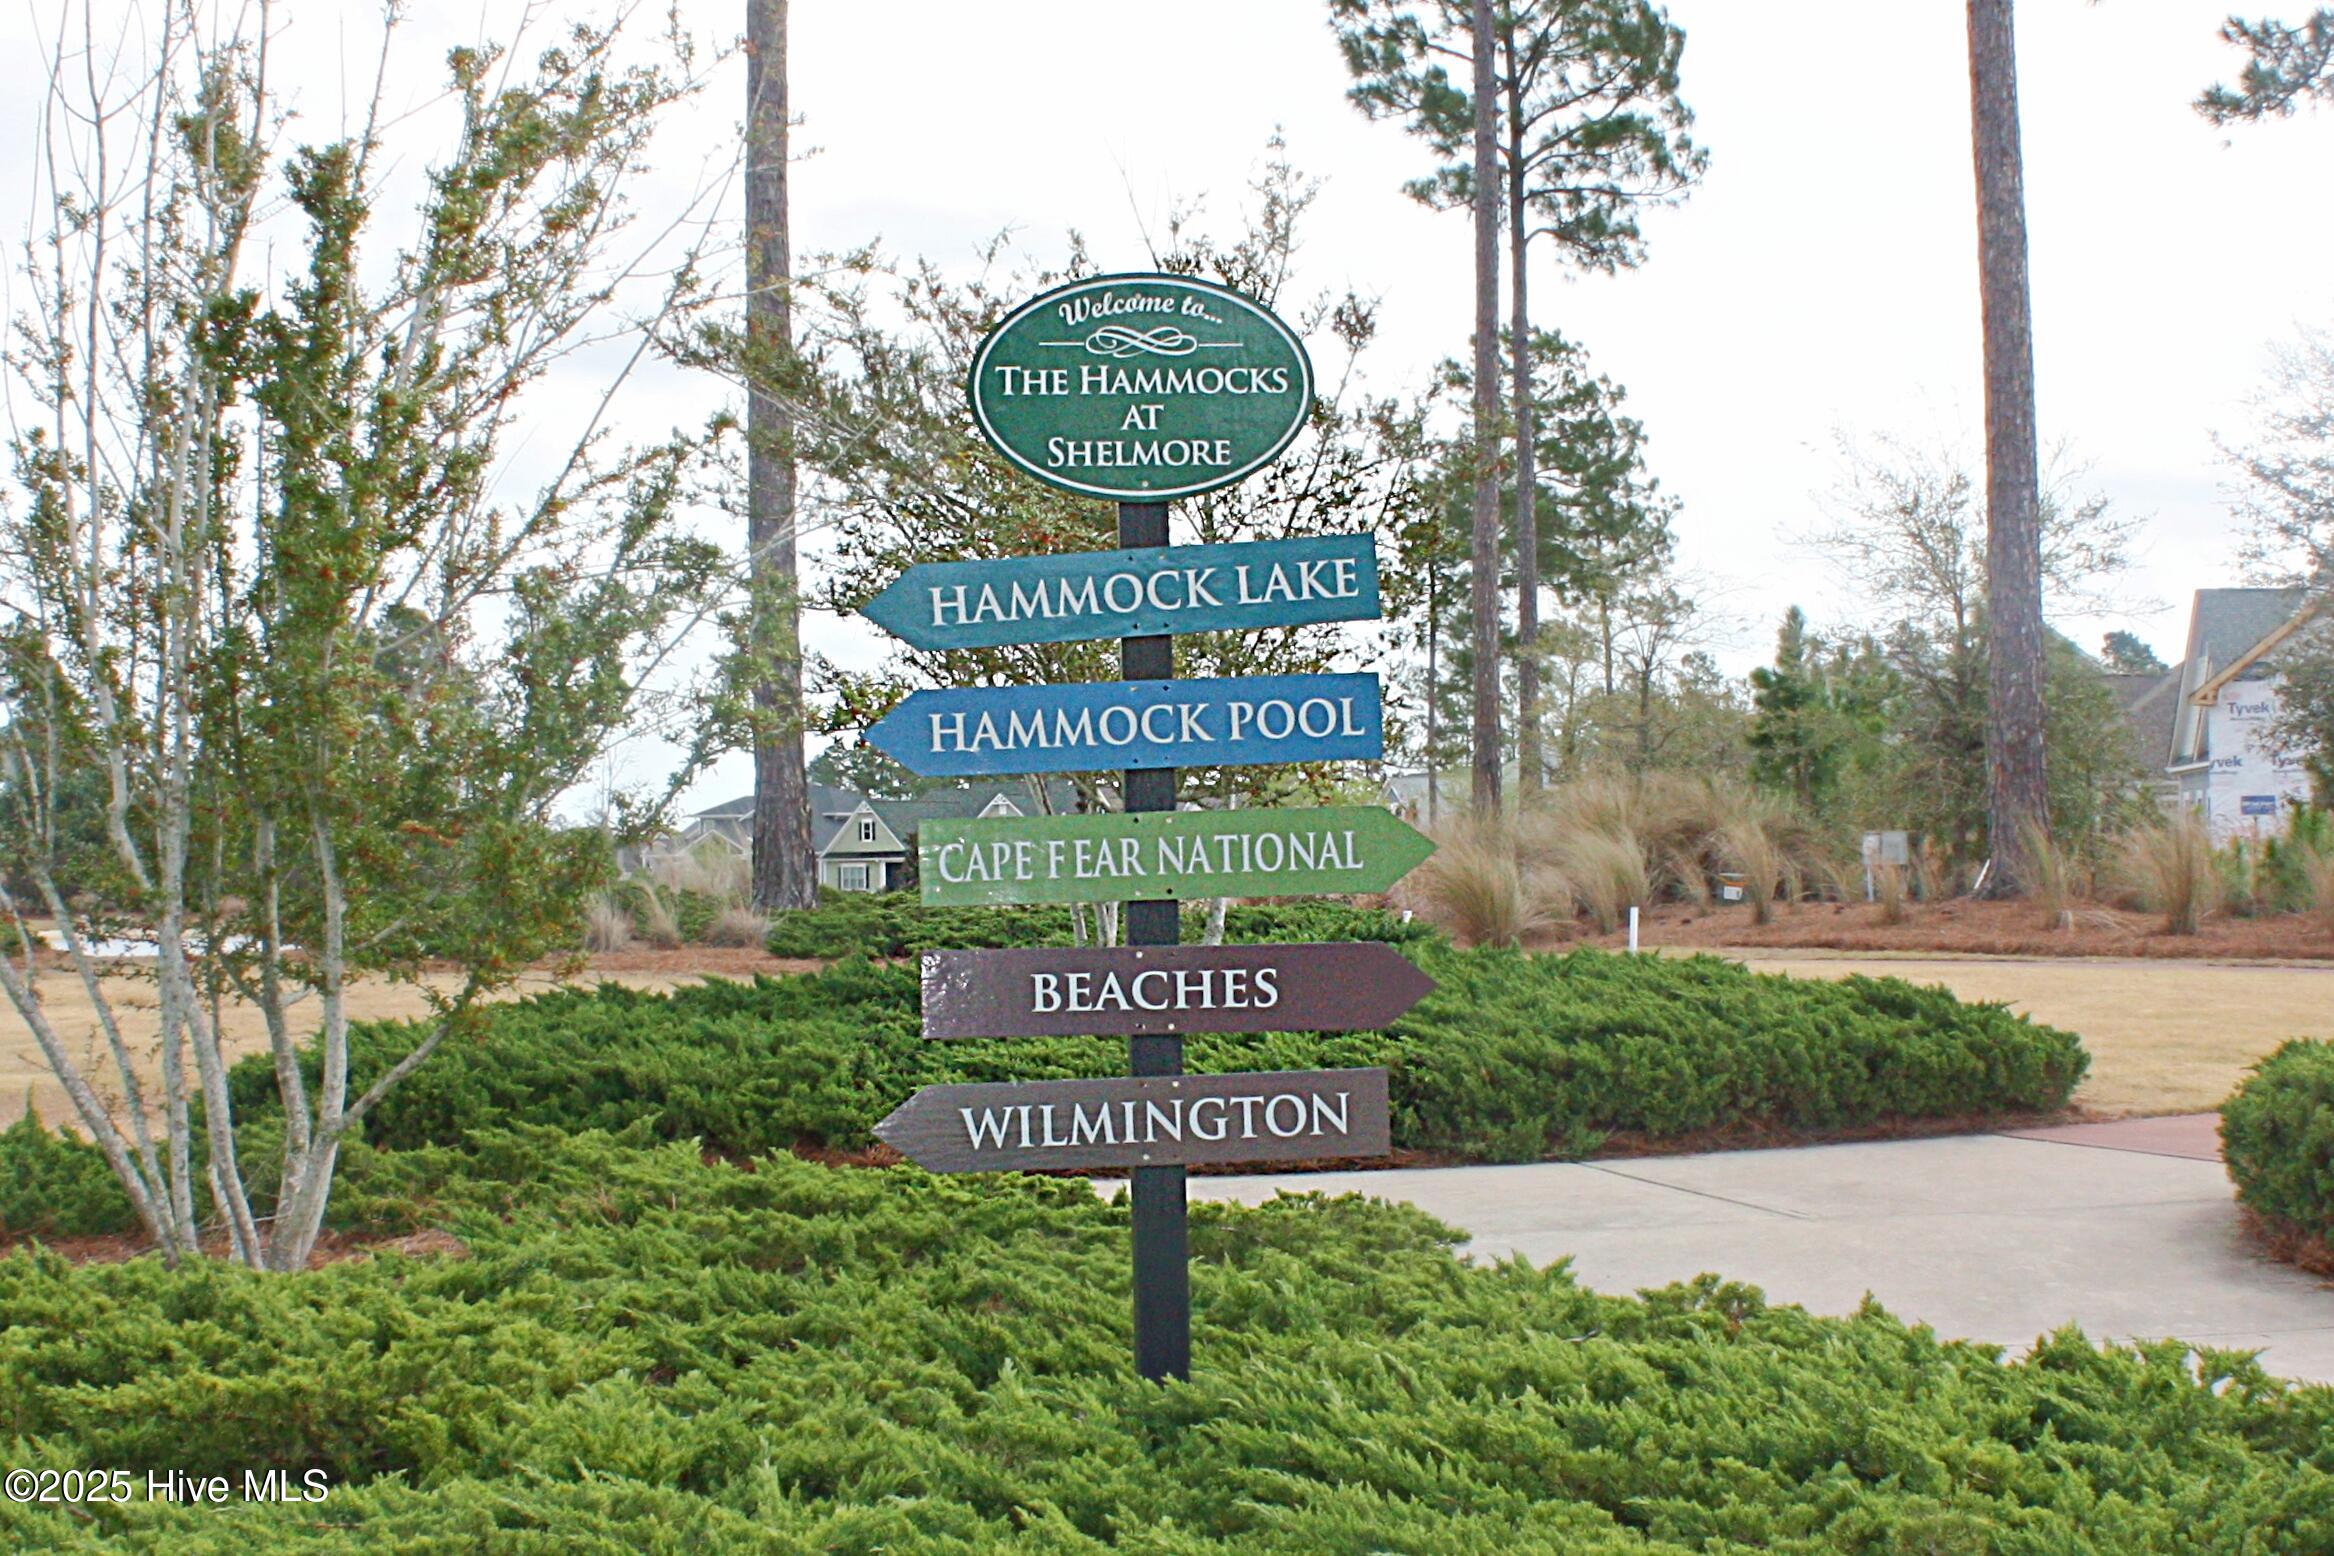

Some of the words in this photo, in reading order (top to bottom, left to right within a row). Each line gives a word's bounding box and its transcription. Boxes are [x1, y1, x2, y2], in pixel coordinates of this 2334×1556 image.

[1058, 292, 1175, 326] Welcome
[1181, 295, 1223, 324] to...
[1120, 404, 1164, 431] AT
[928, 567, 1222, 627] HAMMOCK
[1235, 558, 1360, 606] LAKE
[928, 703, 1215, 752] HAMMOCK
[1228, 697, 1366, 741] POOL
[2227, 702, 2270, 716] Tyvek
[2210, 756, 2242, 769] yvek
[938, 841, 1033, 883] CAPE
[1047, 837, 1145, 879] FEAR
[1157, 831, 1364, 875] NATIONAL
[1031, 968, 1279, 1013] BEACHES
[958, 1092, 1351, 1150] WILMINGTON
